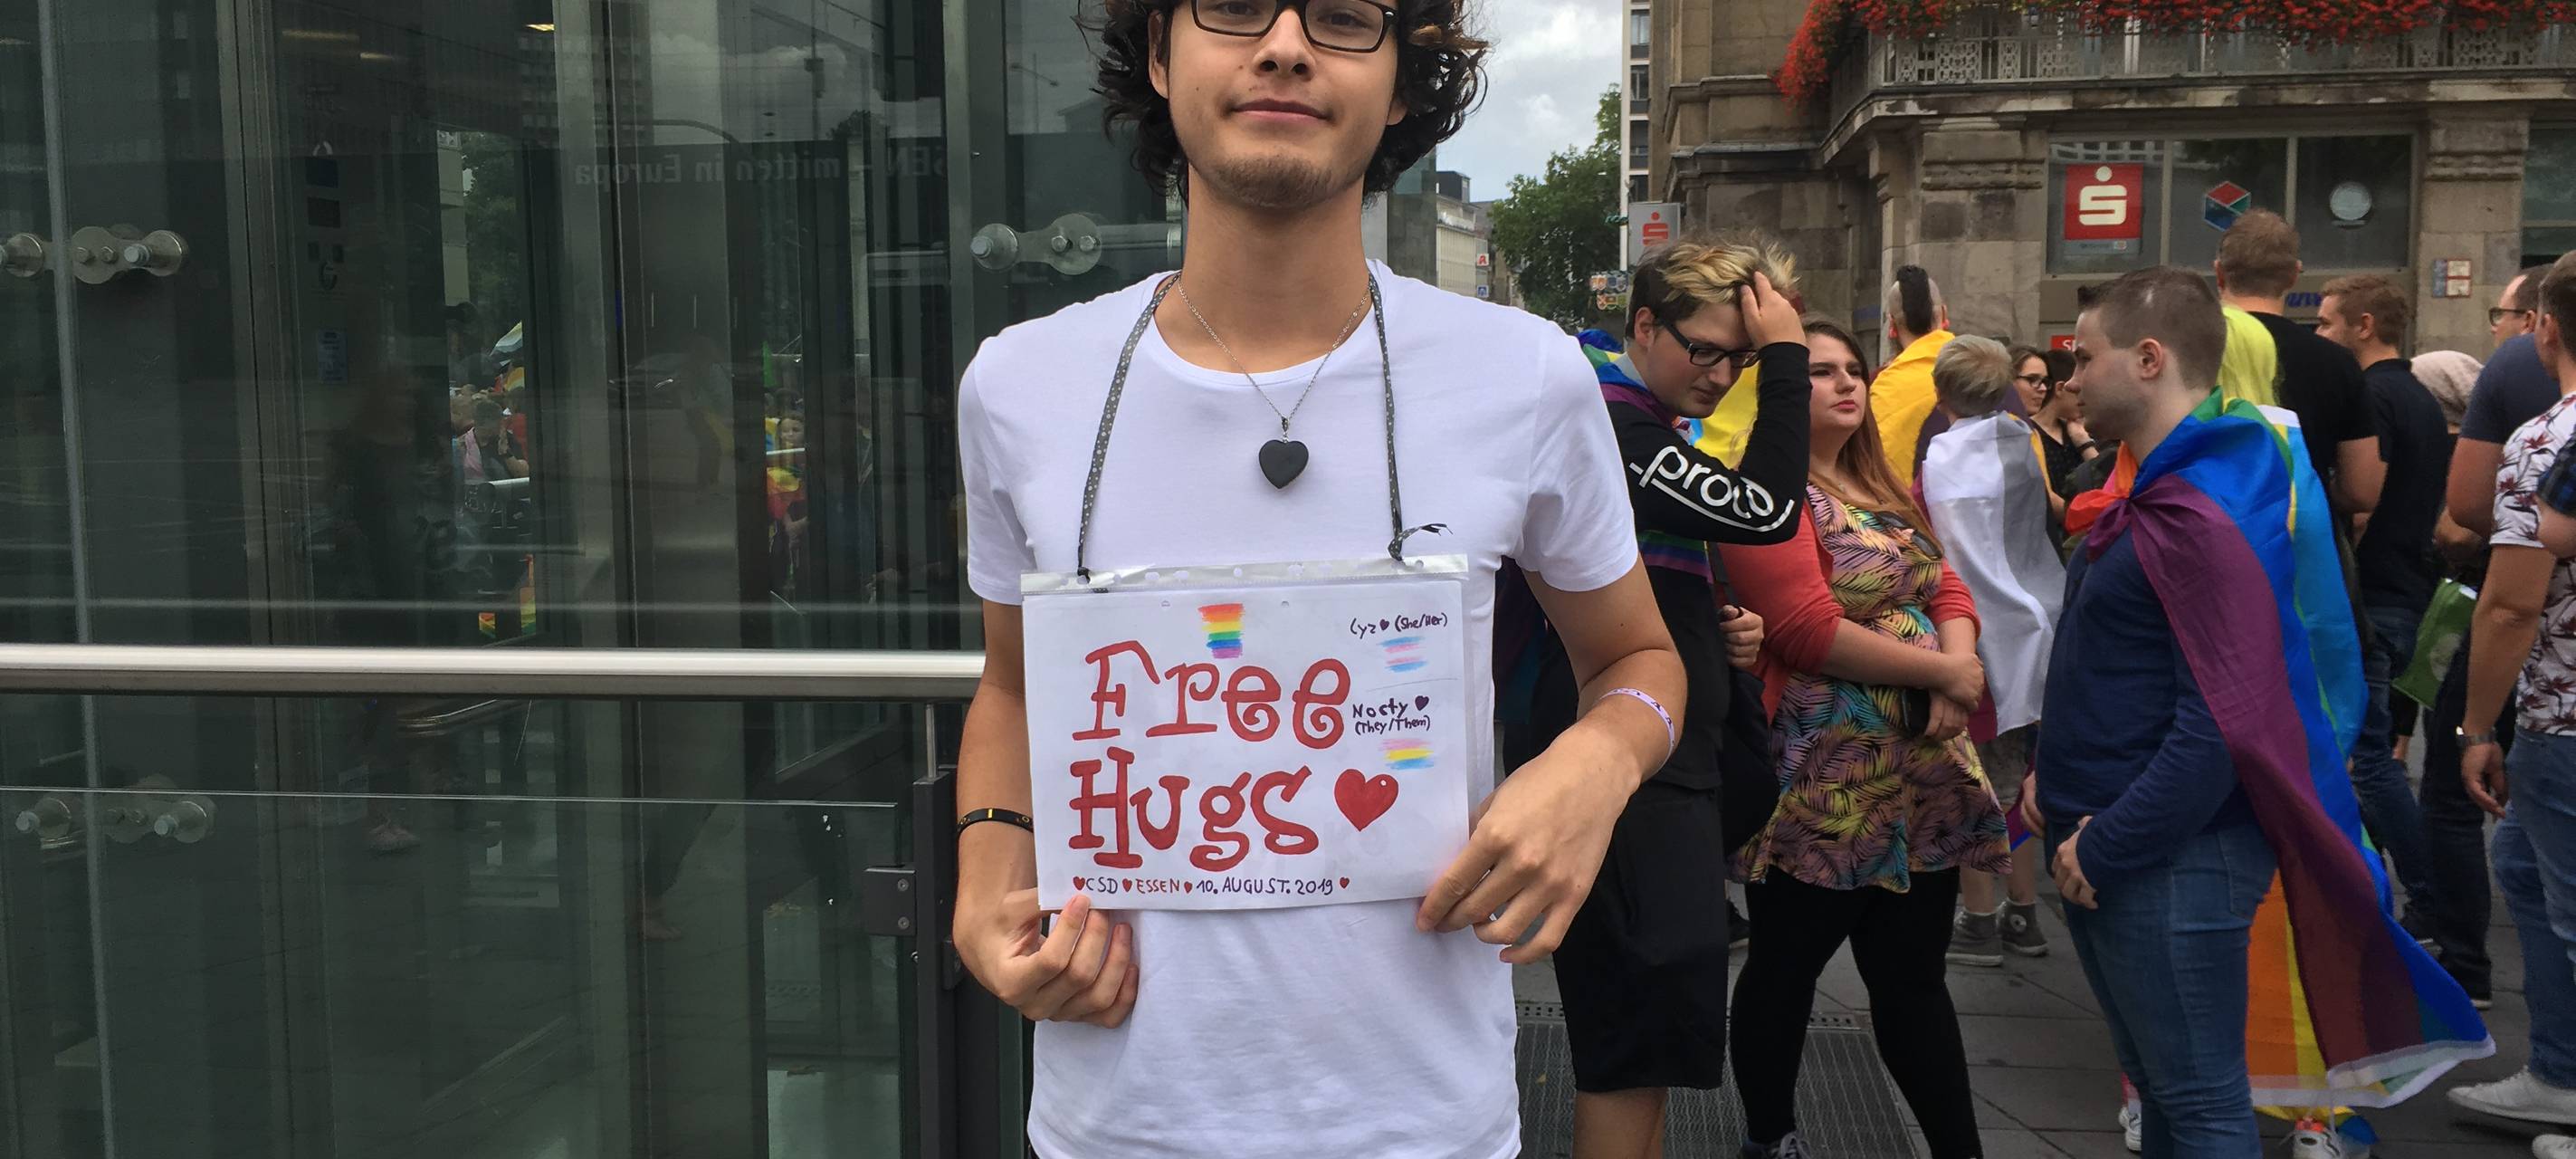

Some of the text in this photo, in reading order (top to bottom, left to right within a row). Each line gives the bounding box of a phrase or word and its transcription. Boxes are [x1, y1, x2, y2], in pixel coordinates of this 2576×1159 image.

[1072, 639, 1351, 750] Free
[1354, 714, 1431, 735] (They/Them)
[1068, 746, 1320, 872] Hugs
[1086, 876, 1333, 896] CSD ESSEN 10. AUGUST. 2019
